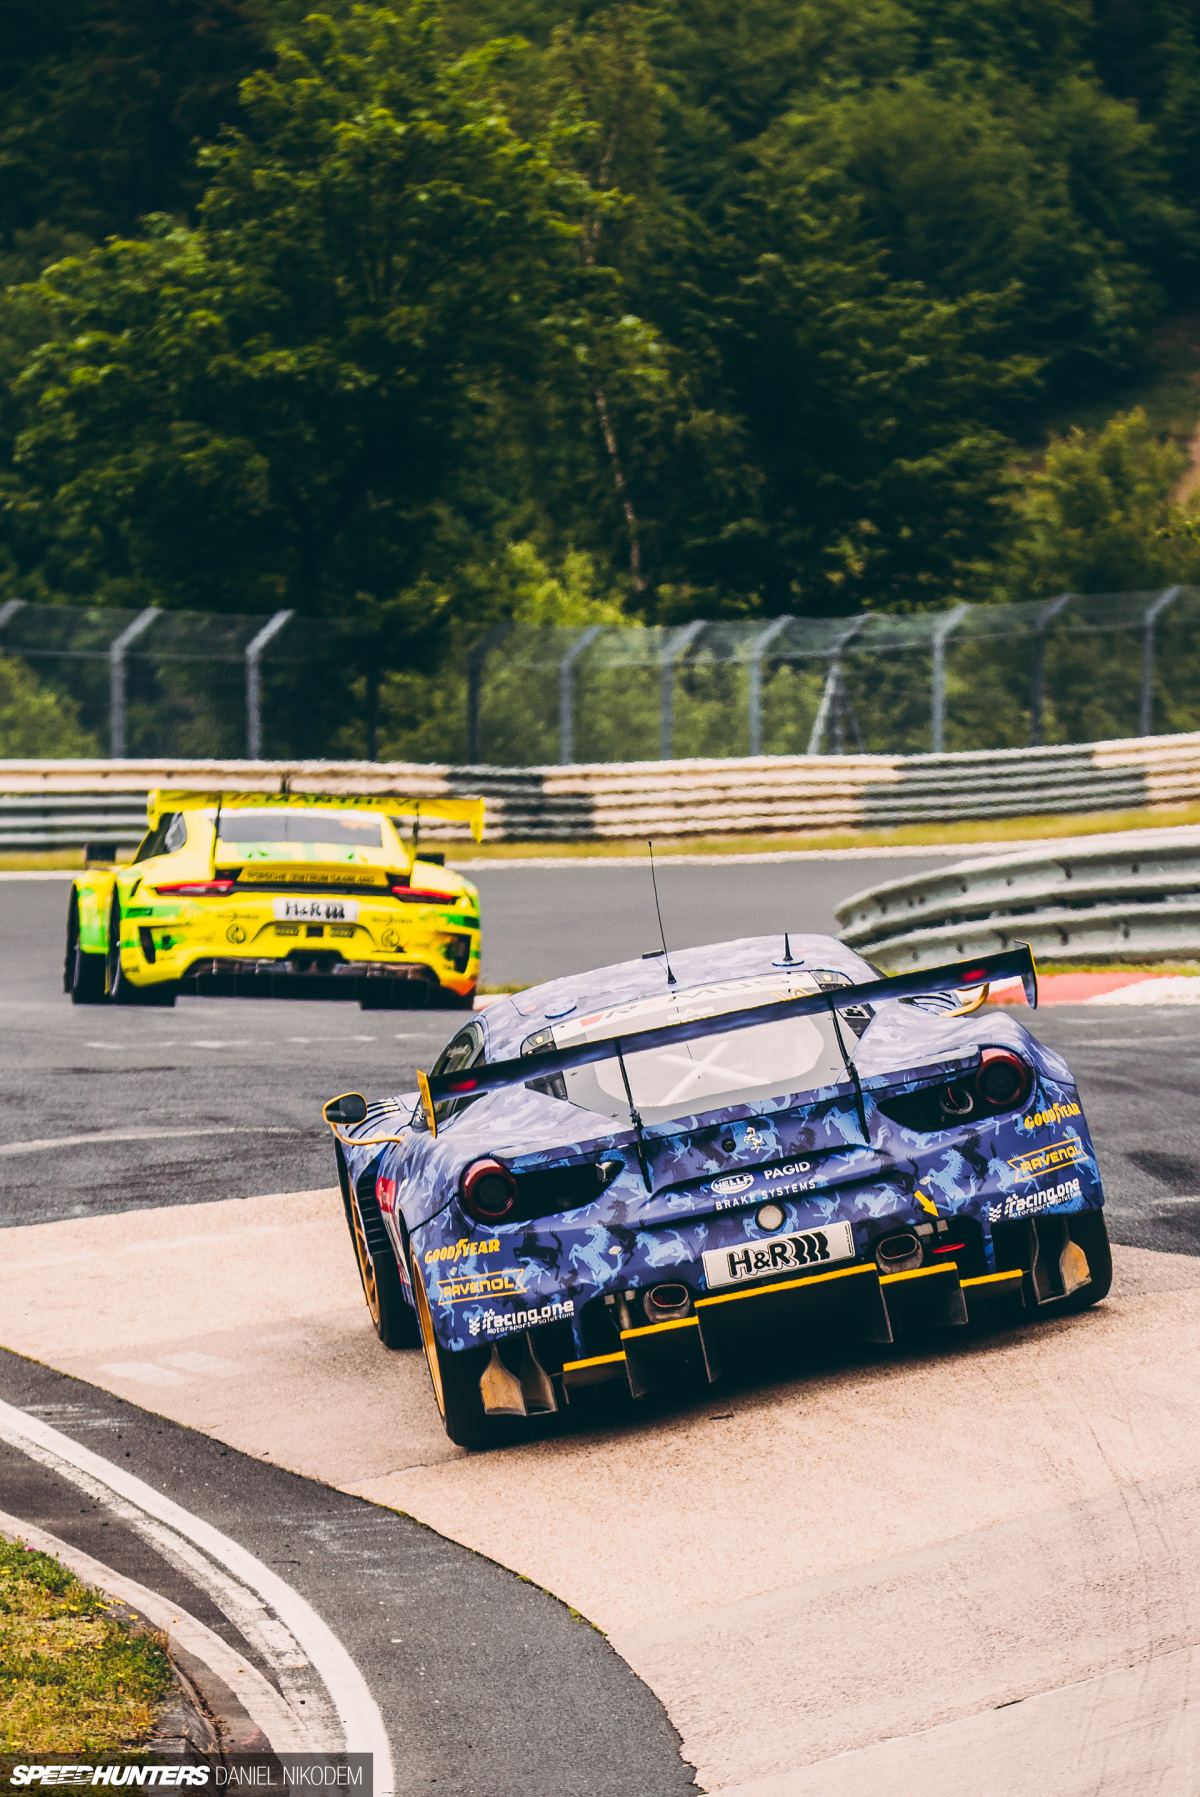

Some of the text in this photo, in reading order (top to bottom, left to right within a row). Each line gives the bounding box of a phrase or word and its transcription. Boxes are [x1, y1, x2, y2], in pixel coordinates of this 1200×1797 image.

[1024, 1103, 1081, 1129] GOODYEAR
[764, 1162, 810, 1180] PAGID
[1020, 1145, 1082, 1174] RAVENOL
[712, 1174, 755, 1191] HELLA
[716, 1181, 816, 1210] BRAKE SYSTEMS
[424, 1238, 501, 1264] GOODYEAR
[728, 1241, 795, 1279] H&R
[443, 1277, 516, 1299] RAVENOL
[487, 1321, 532, 1335] Motorsport
